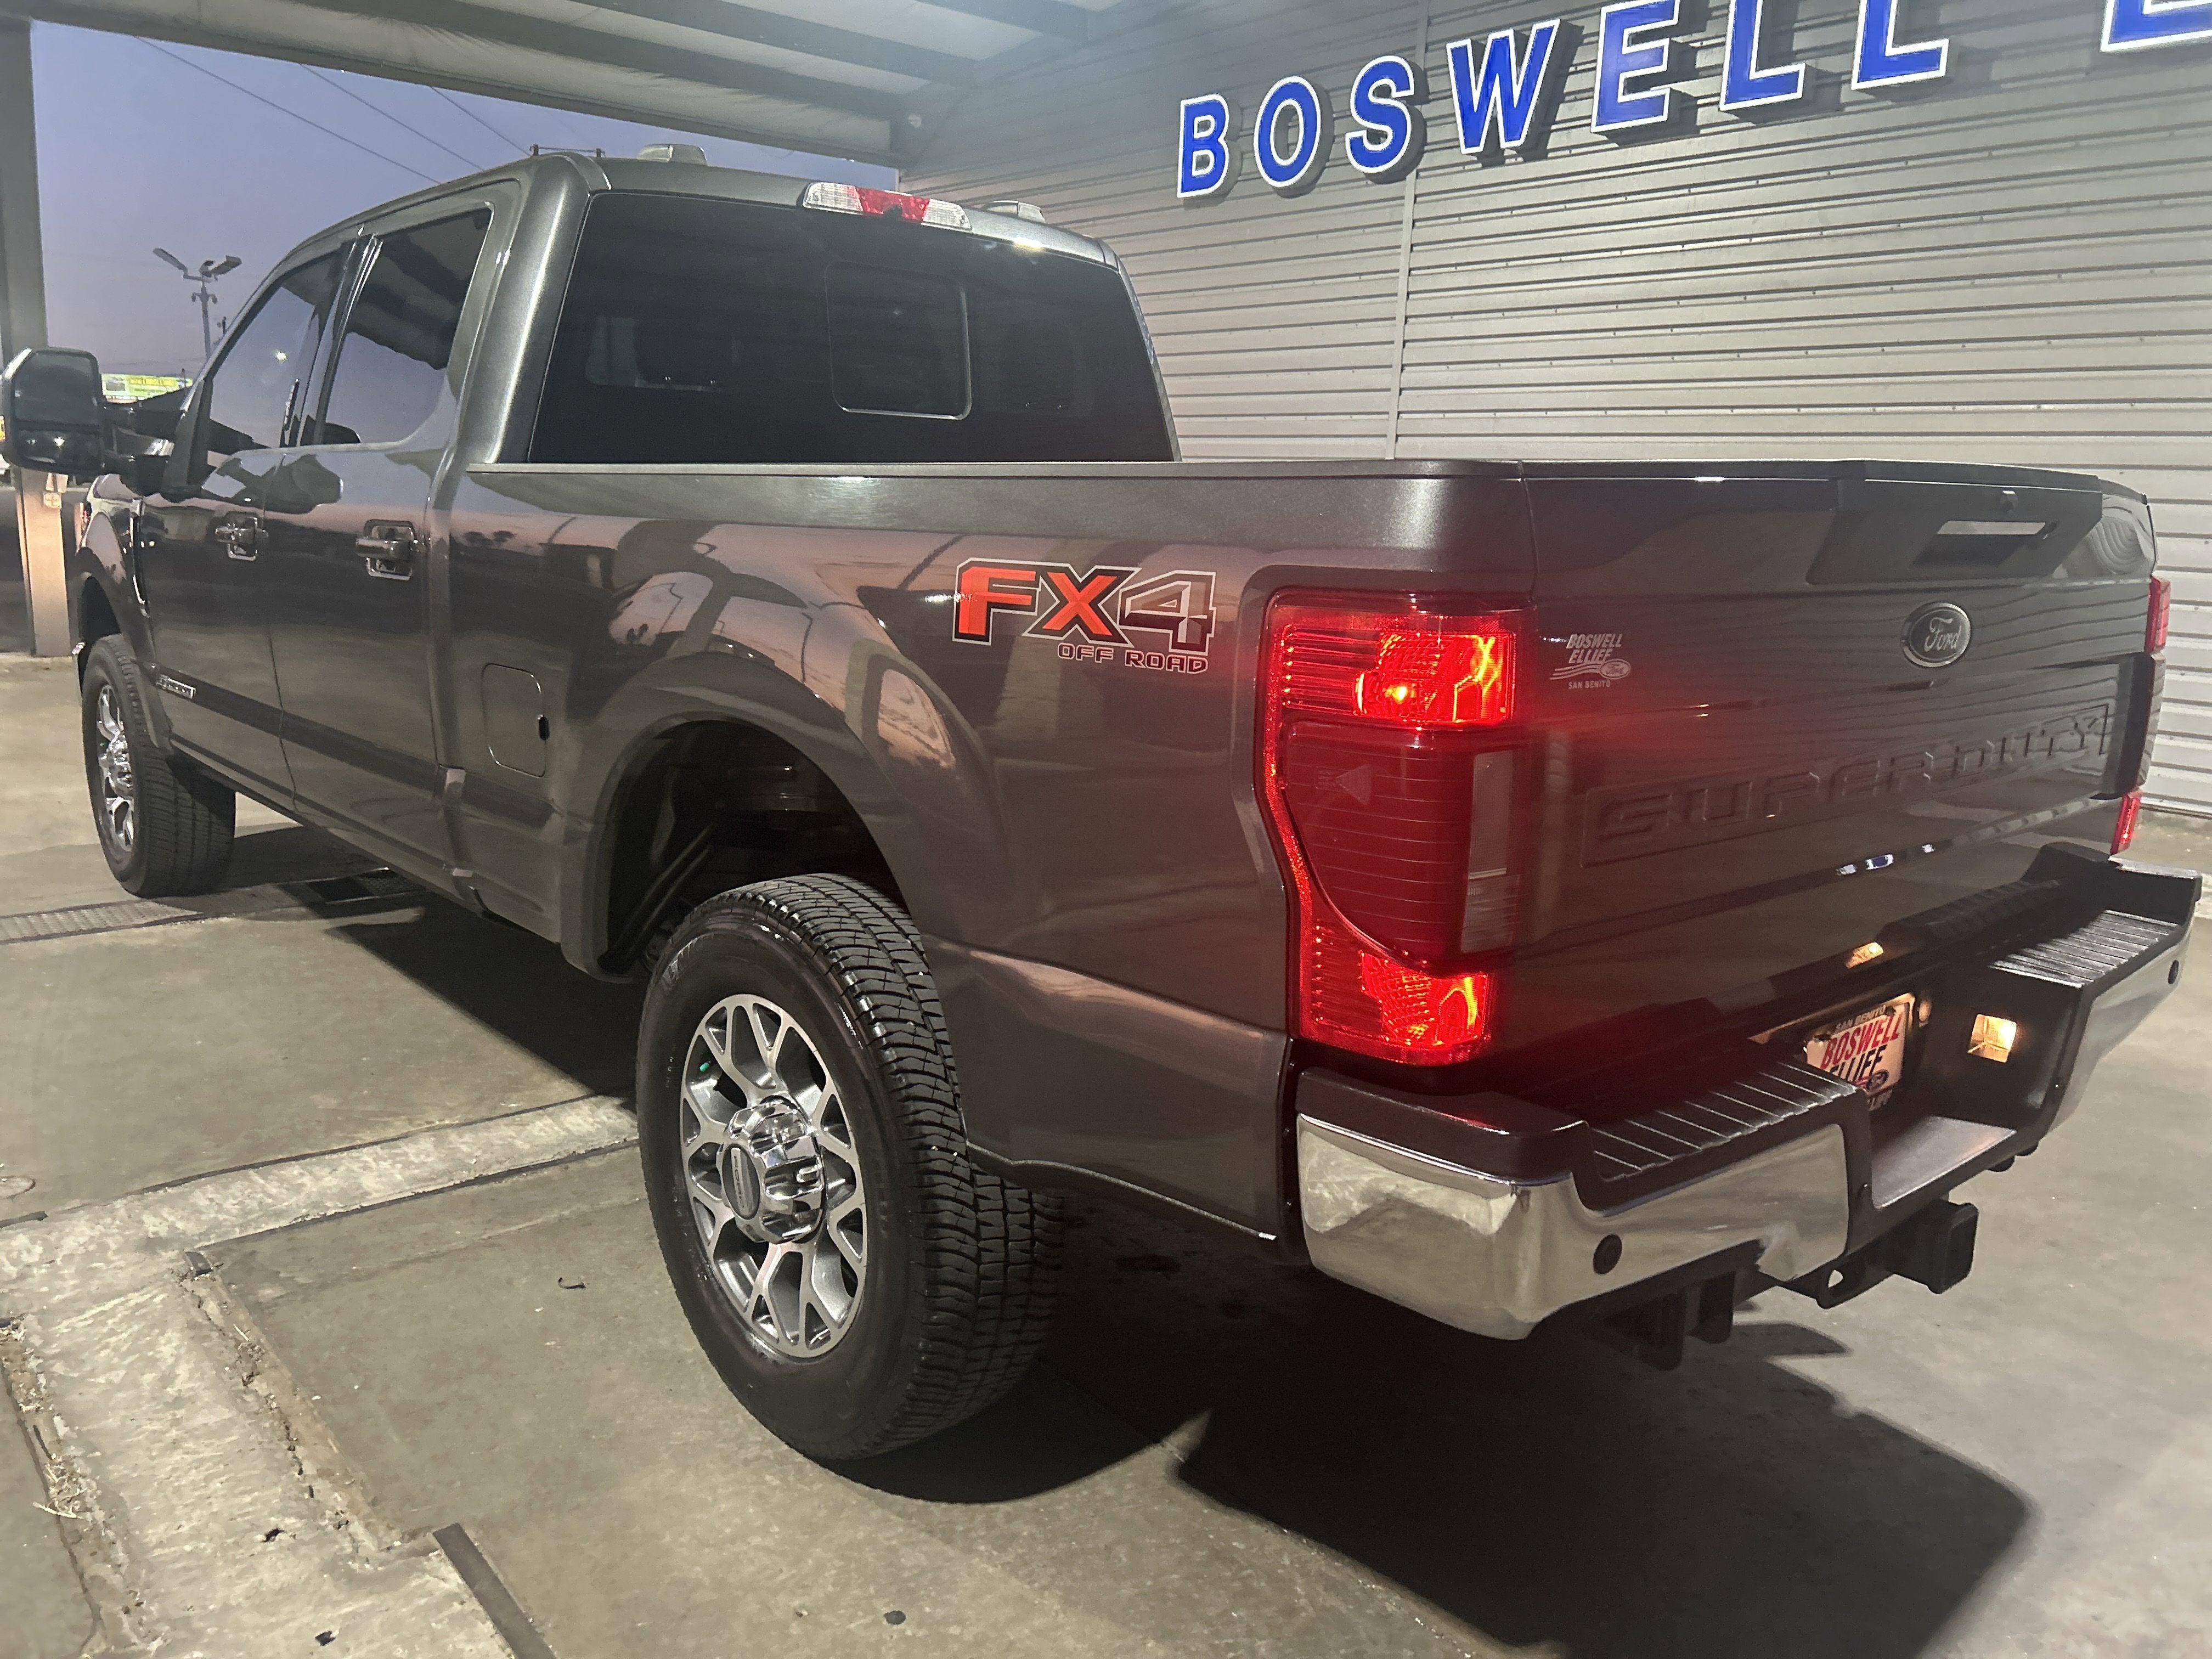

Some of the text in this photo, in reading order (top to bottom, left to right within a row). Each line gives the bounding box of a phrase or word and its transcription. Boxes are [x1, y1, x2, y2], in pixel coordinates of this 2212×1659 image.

[1177, 0, 1949, 198] BOSWELL
[952, 557, 1216, 656] FX4
[1566, 634, 1623, 649] BOSWELL
[1924, 616, 1962, 652] Ford
[1057, 642, 1209, 674] OFF ROAD
[1568, 680, 1611, 690] SAN BENITO
[1595, 749, 1935, 841] SUPER
[1820, 1013, 1903, 1070] BOSWELL
